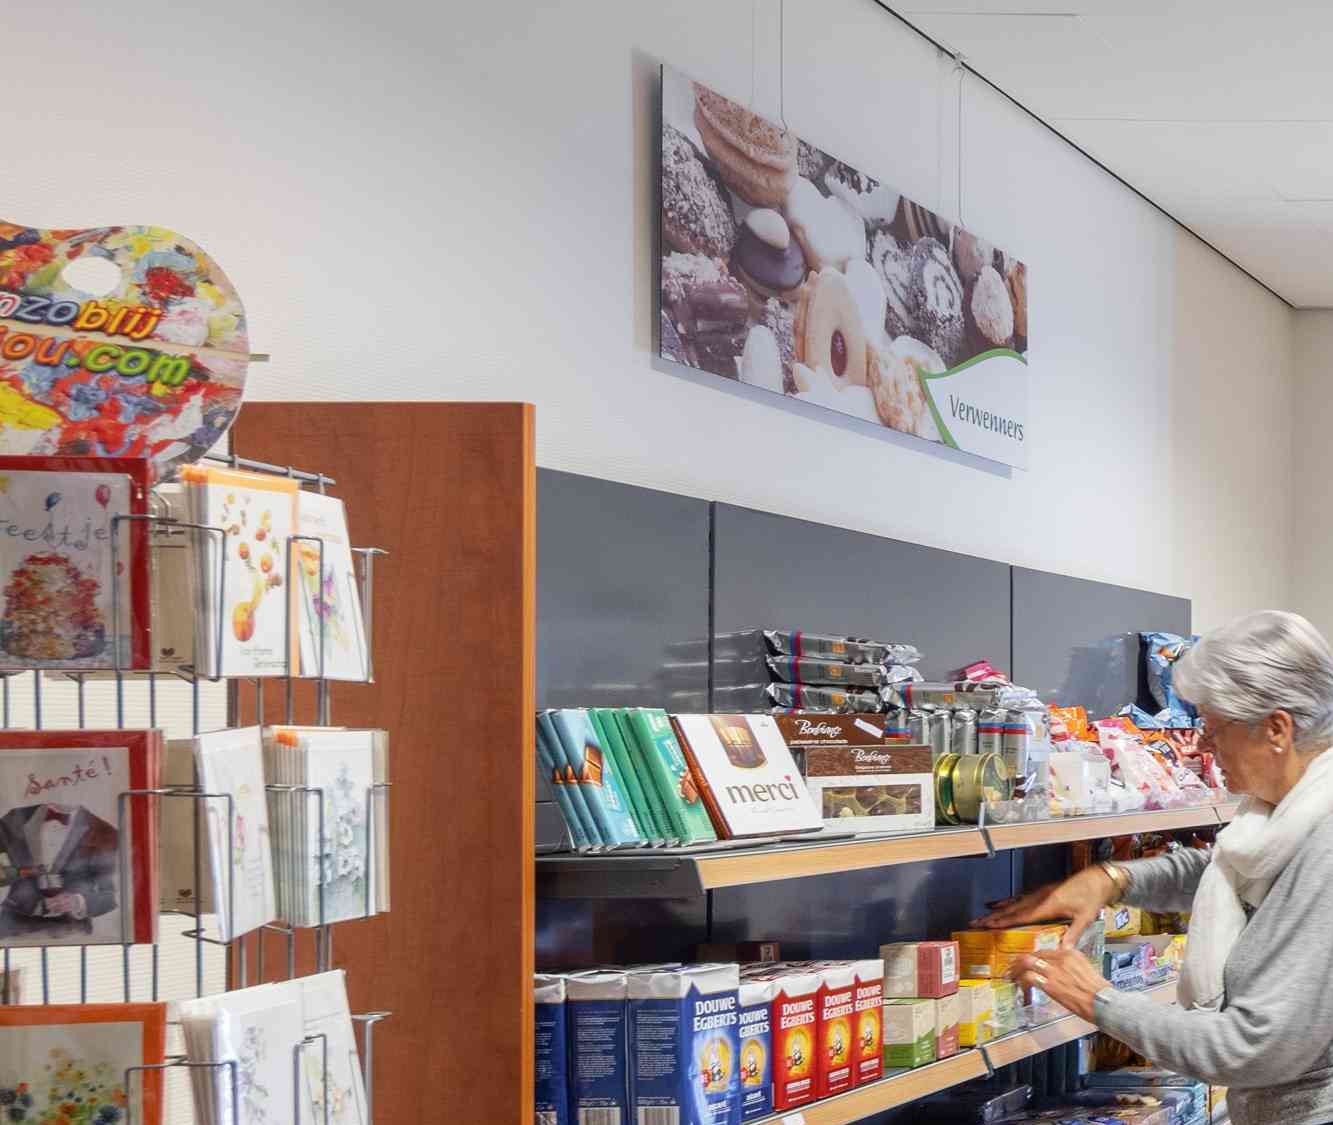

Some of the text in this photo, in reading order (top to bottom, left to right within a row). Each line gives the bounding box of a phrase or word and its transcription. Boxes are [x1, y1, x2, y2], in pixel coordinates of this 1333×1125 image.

[949, 394, 1025, 441] Verwenners
[24, 756, 113, 796] Santé!
[726, 782, 800, 804] merci
[693, 1011, 738, 1032] EGBERTS
[739, 1021, 770, 1038] GBERTS
